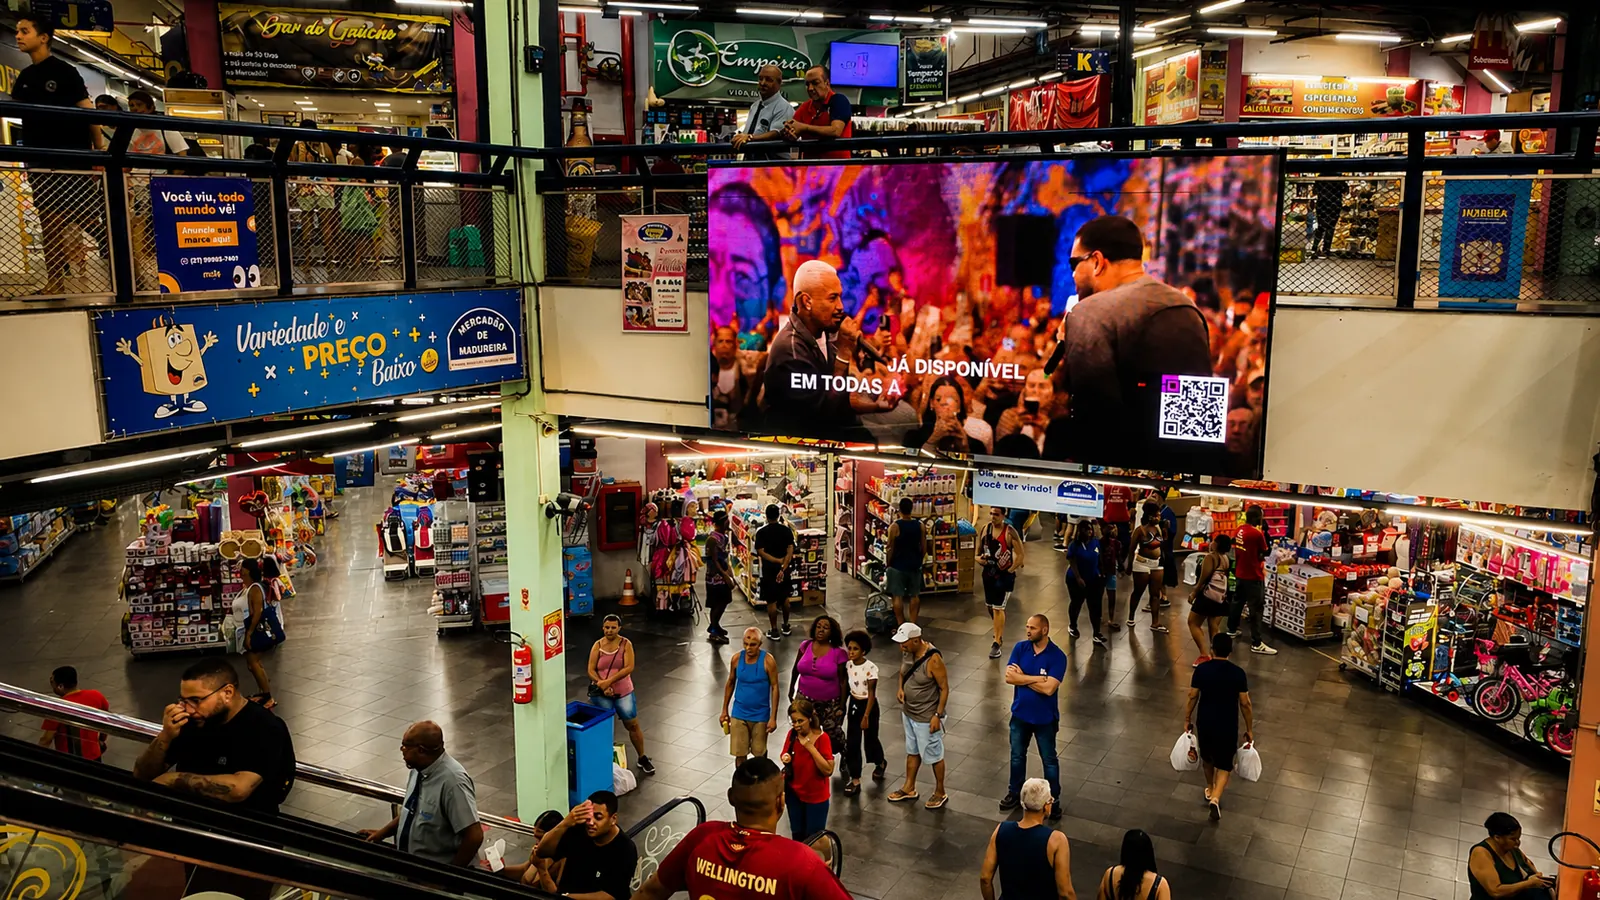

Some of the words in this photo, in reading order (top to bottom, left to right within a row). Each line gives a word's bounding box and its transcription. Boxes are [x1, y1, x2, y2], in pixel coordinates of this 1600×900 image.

[60, 4, 78, 28] J
[305, 20, 325, 35] do
[1077, 53, 1092, 71] K
[161, 191, 193, 202] Você
[195, 192, 216, 204] viu,
[218, 192, 245, 202] todo
[174, 204, 216, 215] mundo
[219, 203, 236, 215] vê!
[182, 226, 215, 234] Anuncie
[213, 236, 231, 244] aqui!
[237, 313, 329, 353] Variedade
[335, 319, 346, 335] e
[457, 315, 505, 336] MERCADÃO
[477, 331, 488, 340] DE
[302, 332, 387, 371] PREÇO
[459, 342, 508, 356] MADUREIRA
[371, 353, 417, 387] Baixo
[887, 354, 910, 373] JÁ
[915, 357, 1026, 380] DISPONÍVEL
[790, 373, 817, 389] EM
[821, 375, 883, 395] TODAS
[978, 480, 1001, 488] você
[1004, 482, 1018, 490] ter
[1021, 483, 1052, 494] vindo!
[696, 857, 777, 895] WELLINGTON
